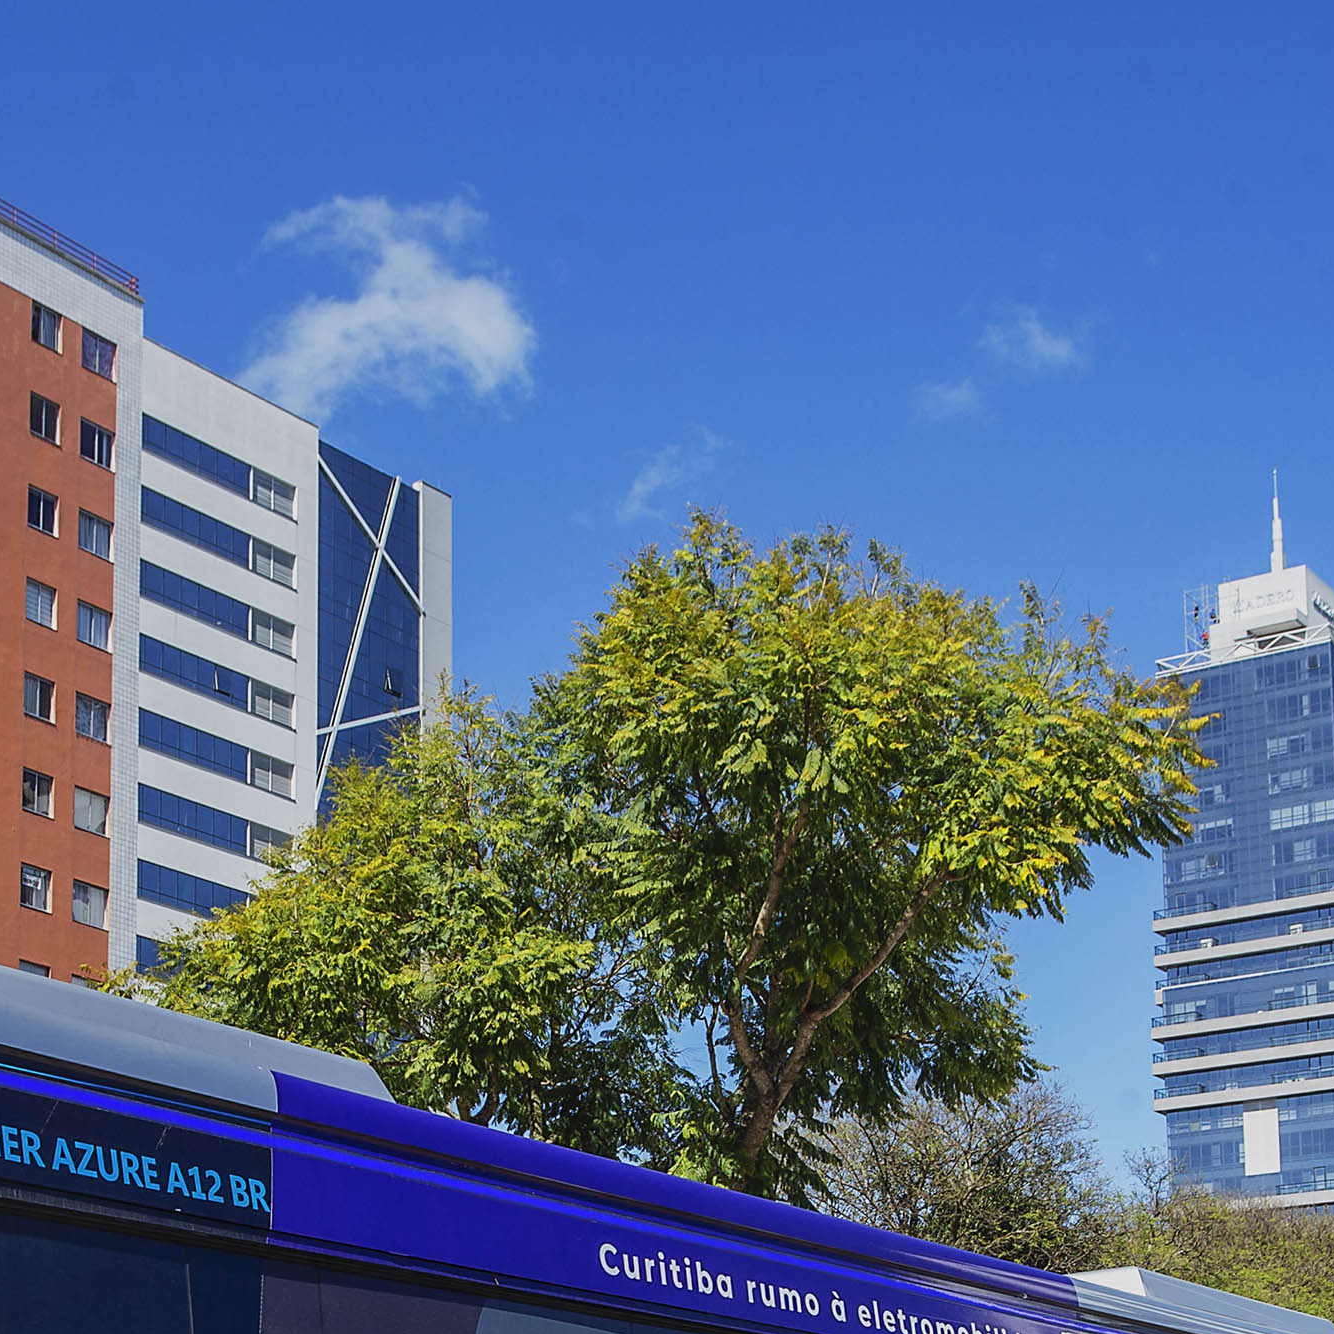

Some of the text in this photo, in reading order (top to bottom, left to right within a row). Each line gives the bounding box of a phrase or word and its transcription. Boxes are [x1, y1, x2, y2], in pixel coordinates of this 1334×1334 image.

[52, 1137, 160, 1191] AZURE
[167, 1162, 224, 1204] A12
[229, 1174, 270, 1213] BR
[599, 1242, 734, 1299] Curitiba
[747, 1278, 820, 1316] rumo
[832, 1290, 847, 1322] à
